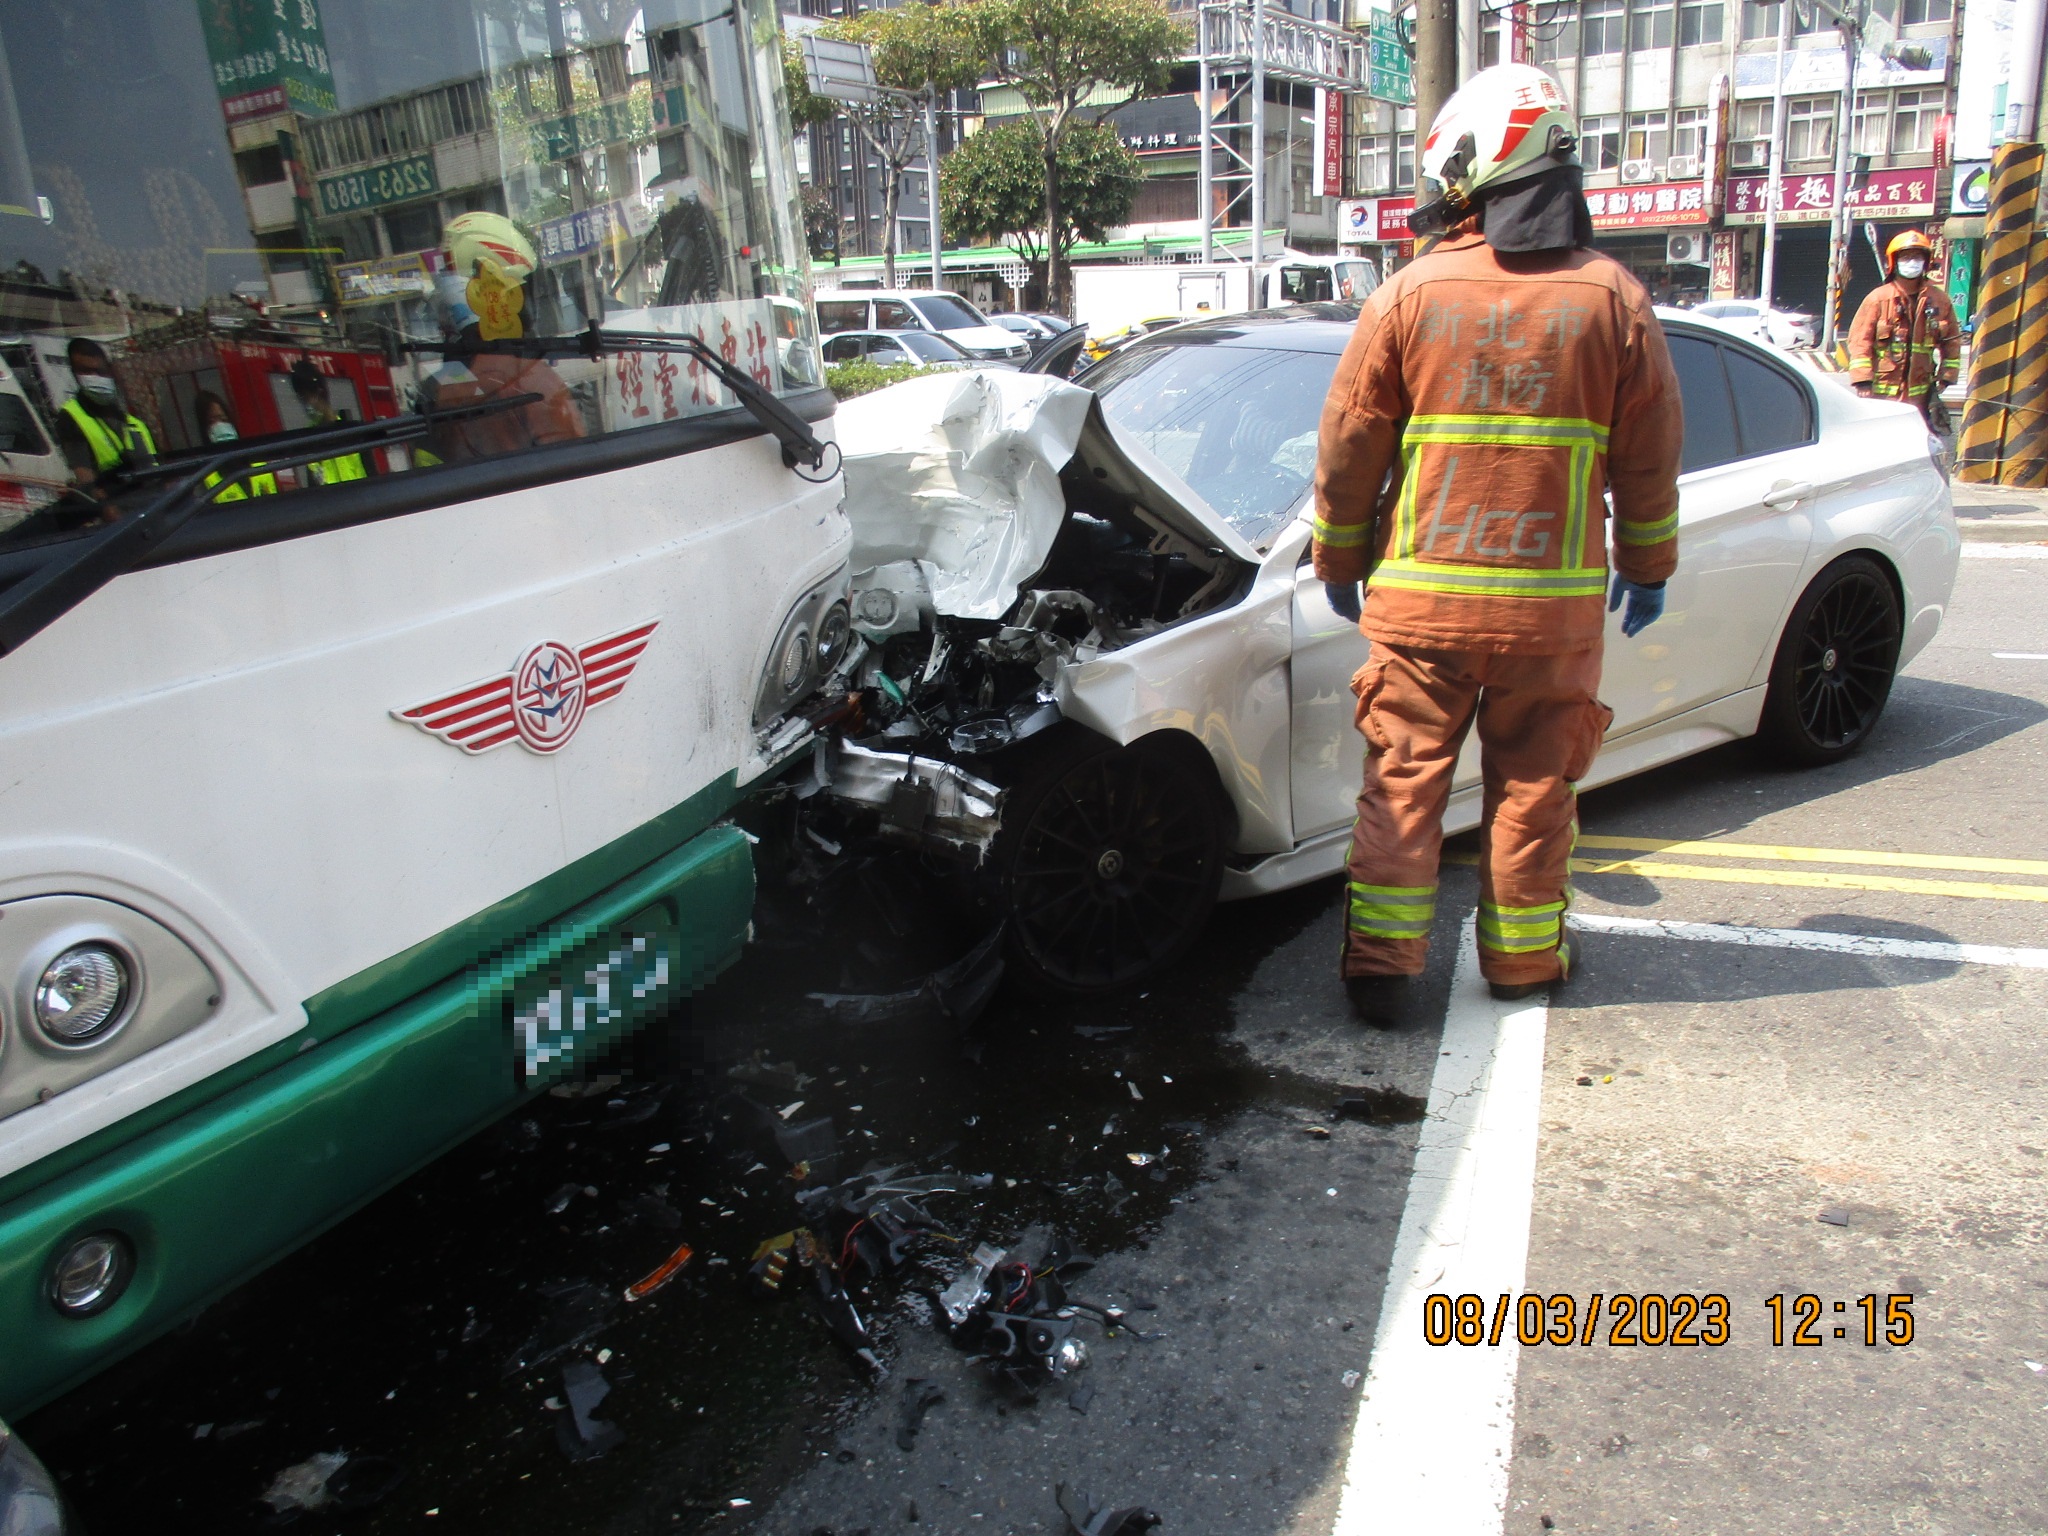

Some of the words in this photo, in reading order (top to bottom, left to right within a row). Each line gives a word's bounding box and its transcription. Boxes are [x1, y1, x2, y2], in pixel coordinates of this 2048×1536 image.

[1745, 212, 1788, 223] 兩性品
[1417, 299, 1592, 349] 新北市
[1443, 358, 1553, 411] 消防
